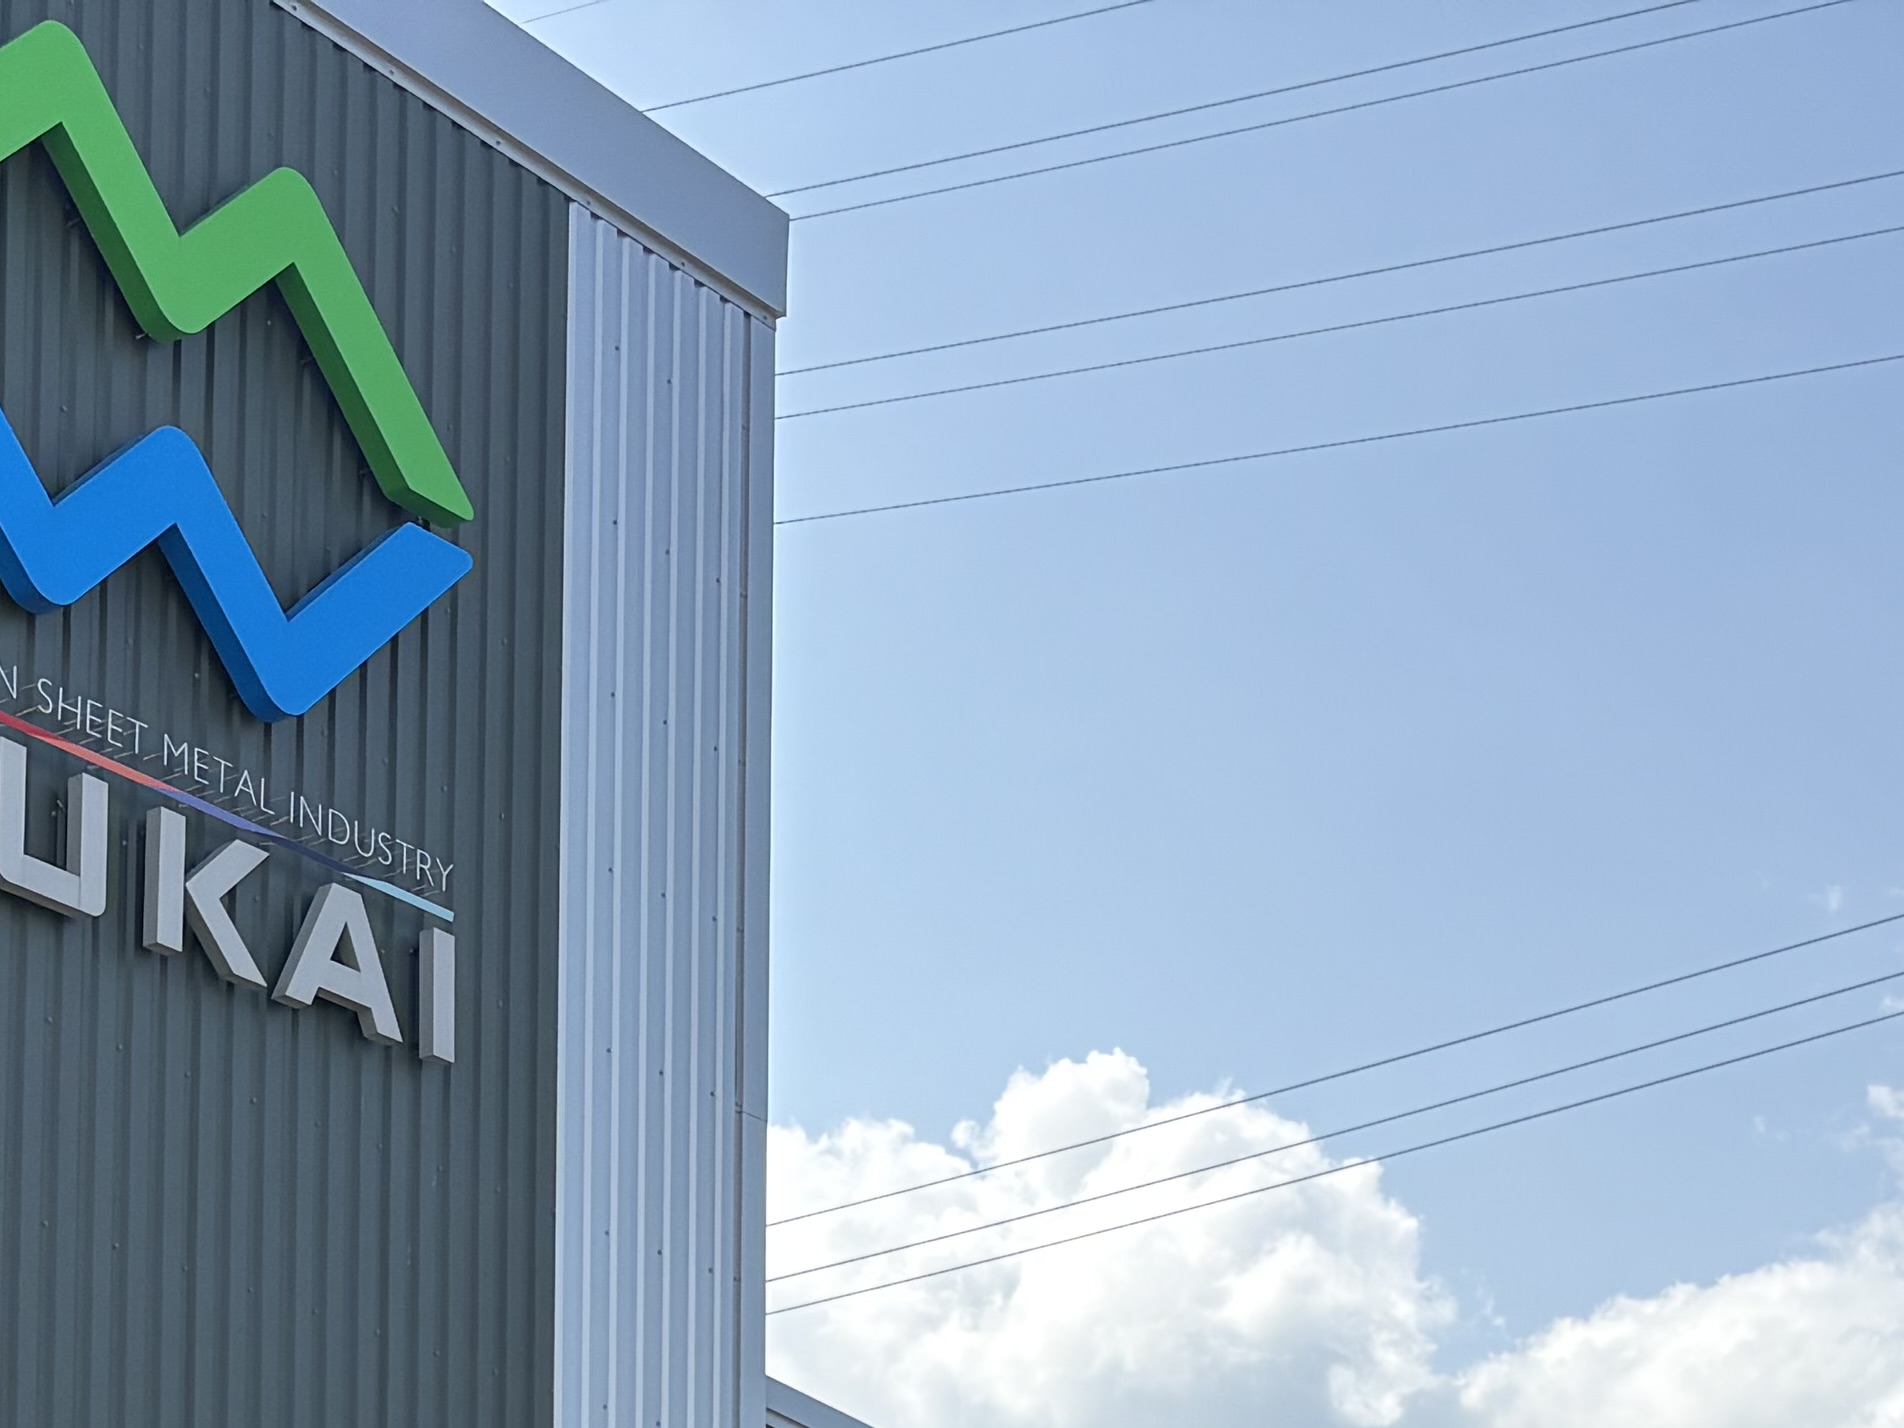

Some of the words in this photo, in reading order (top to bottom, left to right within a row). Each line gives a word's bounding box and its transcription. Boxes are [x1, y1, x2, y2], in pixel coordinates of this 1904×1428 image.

[37, 678, 149, 755] SHEET
[163, 733, 276, 816] METAL
[290, 791, 454, 892] INDUSTRY
